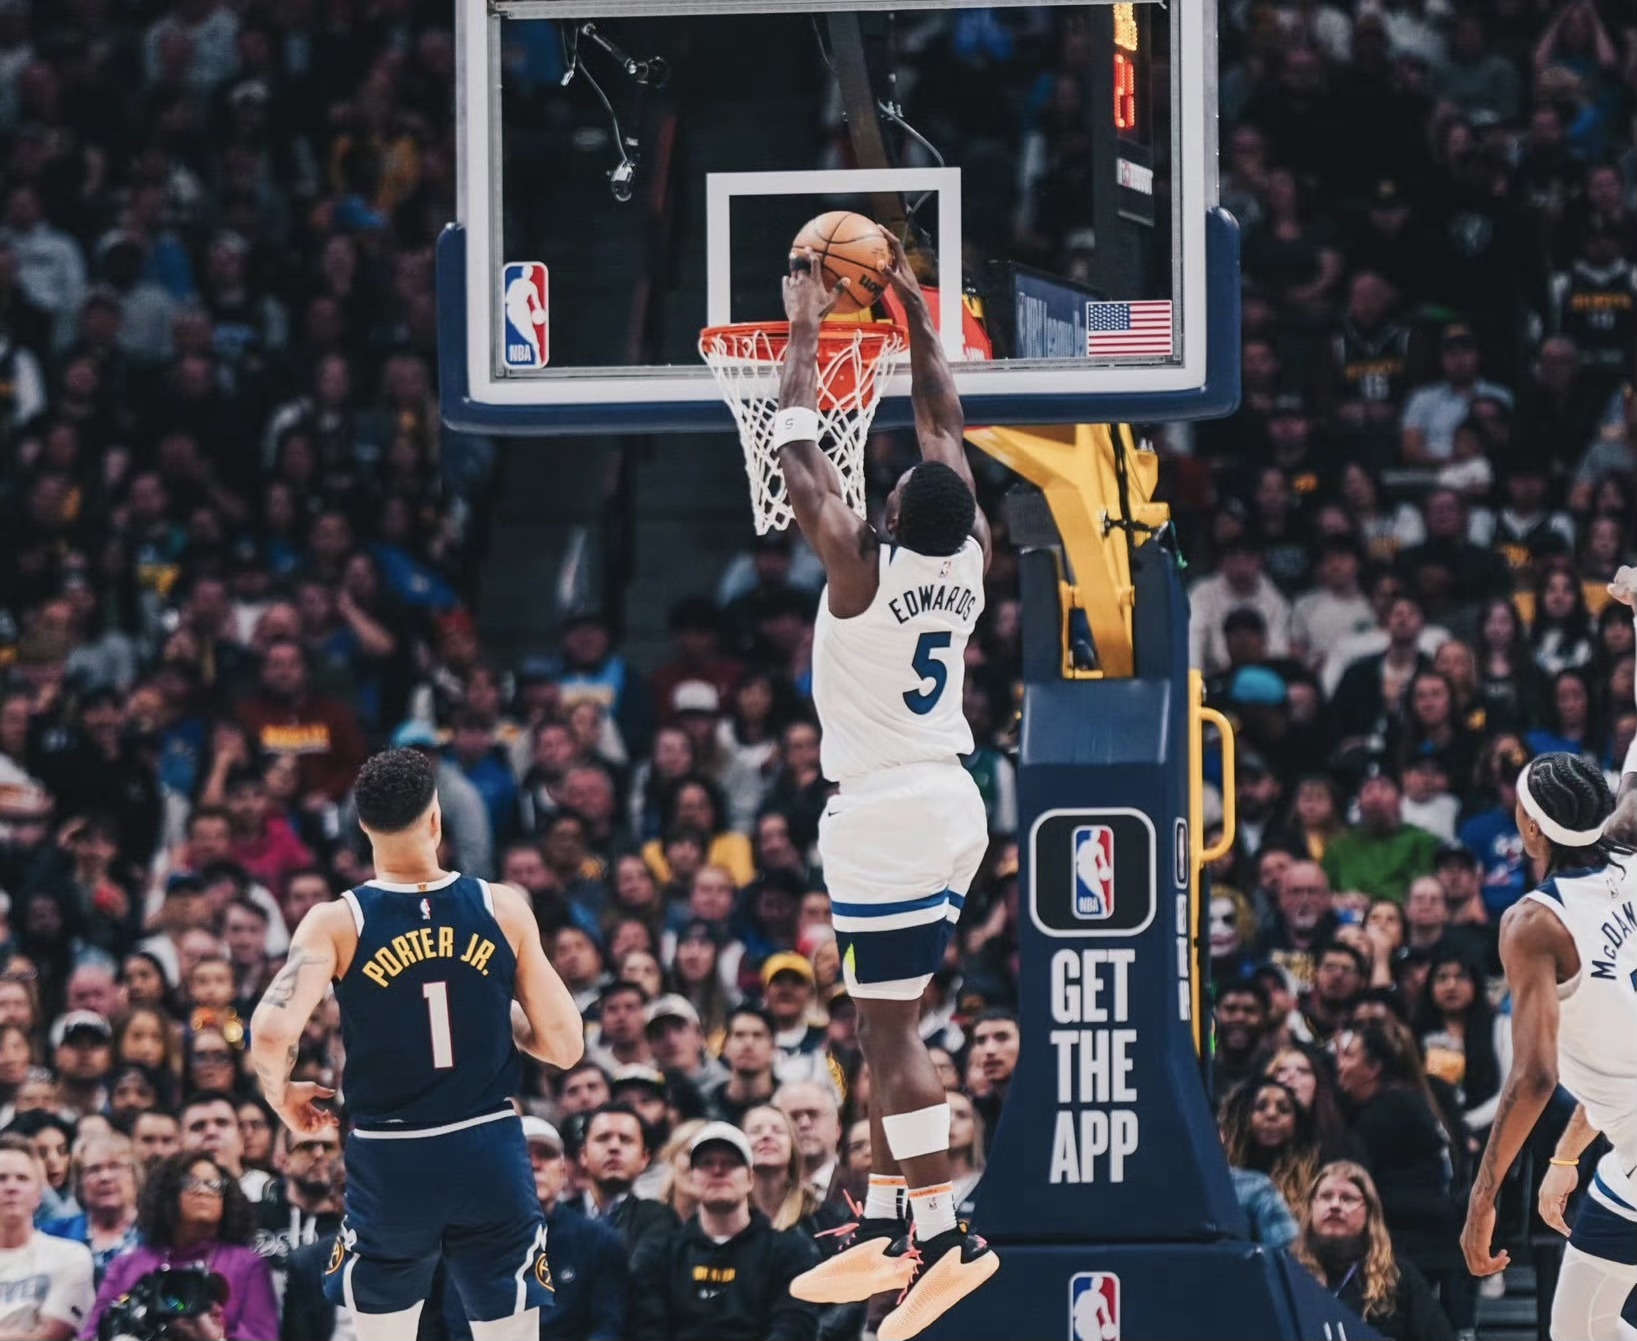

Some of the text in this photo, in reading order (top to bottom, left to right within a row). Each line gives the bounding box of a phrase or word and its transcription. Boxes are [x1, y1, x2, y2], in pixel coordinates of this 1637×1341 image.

[509, 344, 532, 362] NBA
[888, 584, 976, 624] EDWARDS
[902, 631, 952, 715] 5
[1078, 896, 1100, 913] NBA
[362, 926, 496, 988] PORTER JR.
[1051, 949, 1136, 1024] GET
[422, 981, 454, 1069] 1
[1050, 1029, 1138, 1103] THE
[1050, 1110, 1139, 1184] APP
